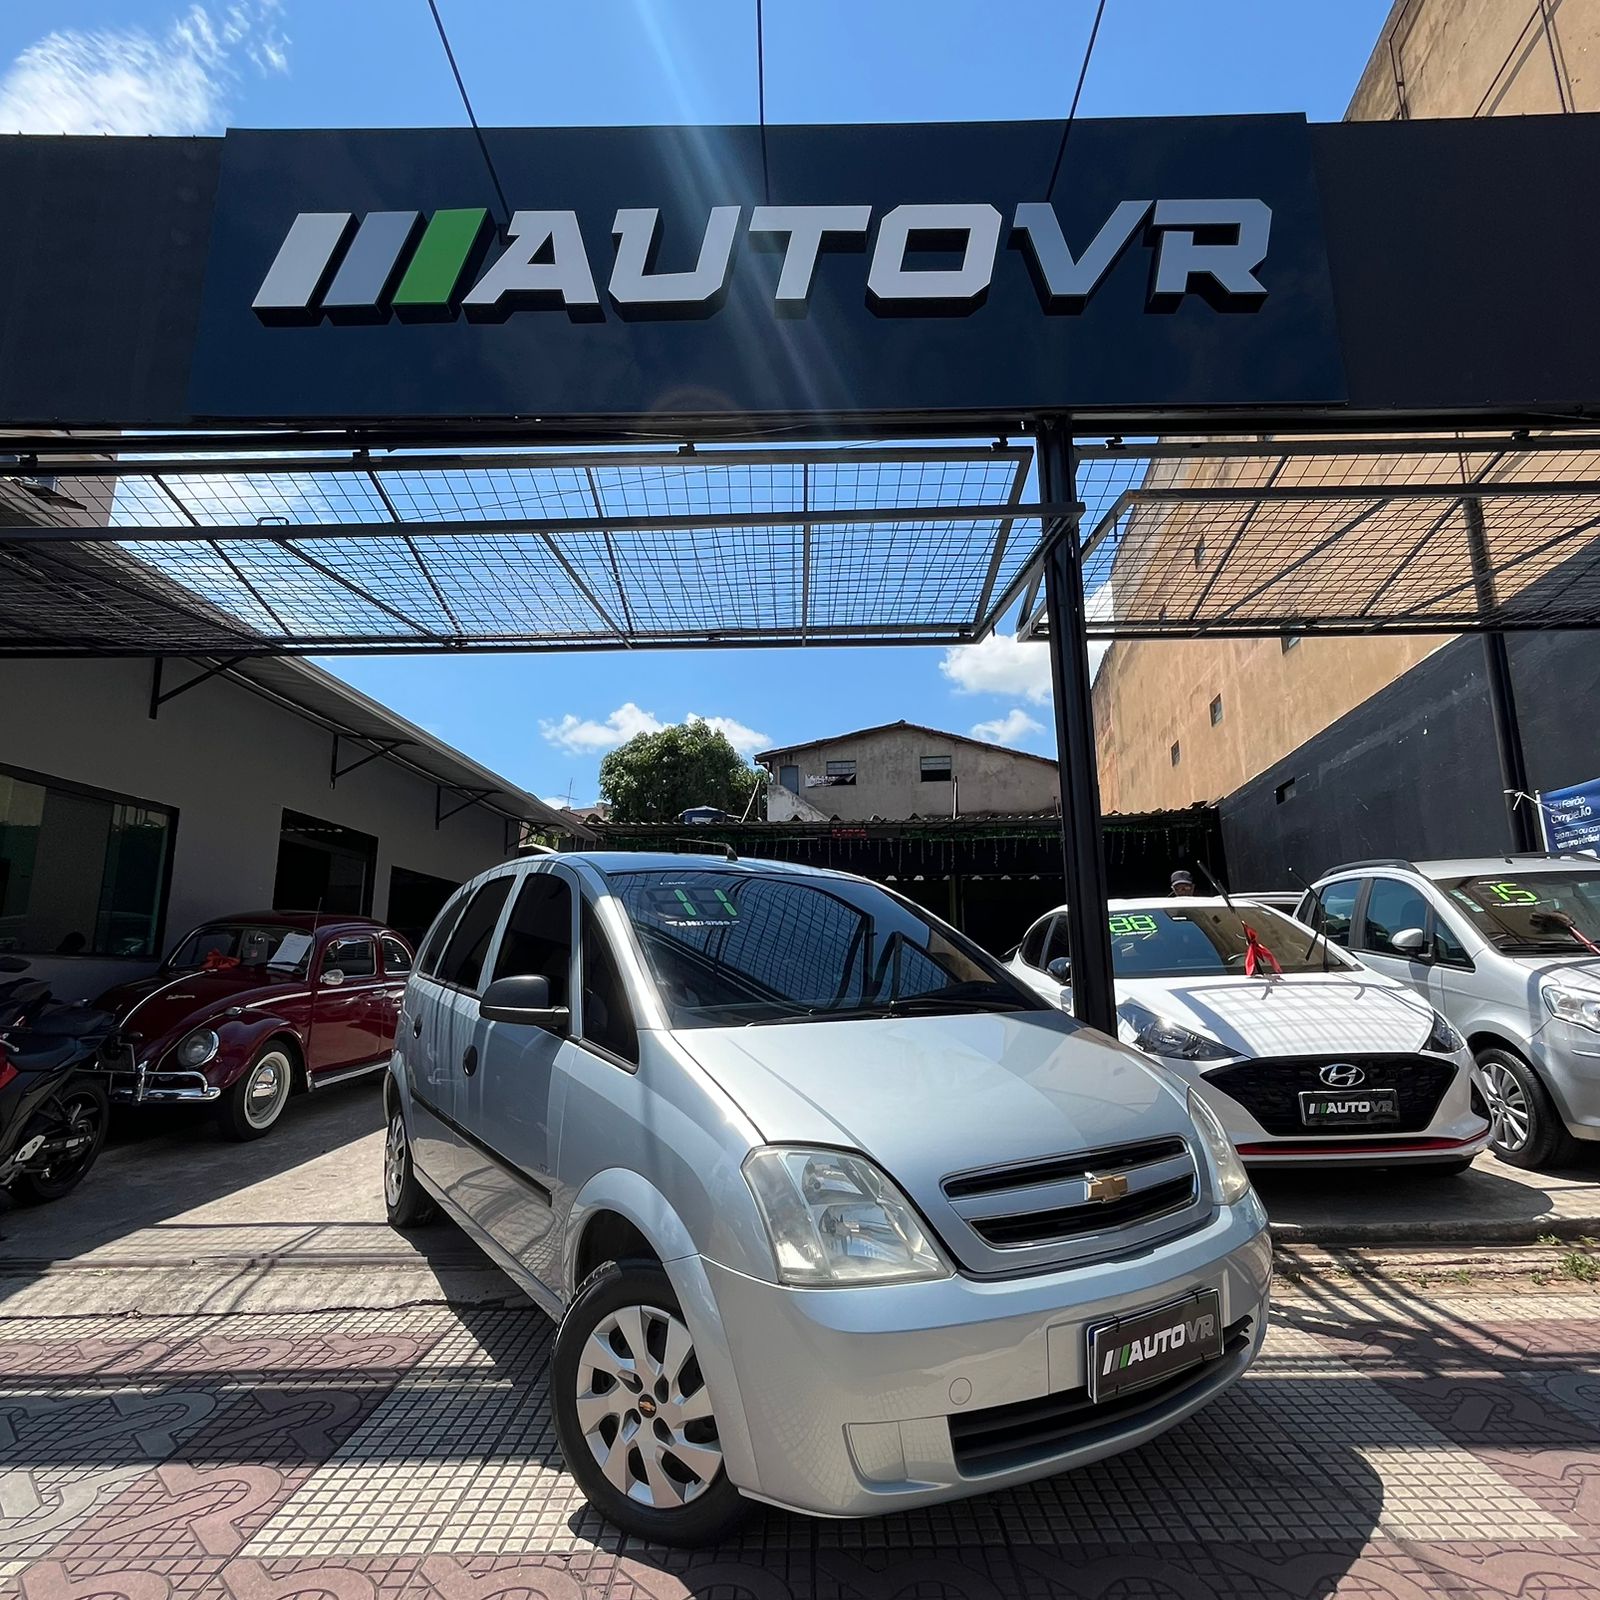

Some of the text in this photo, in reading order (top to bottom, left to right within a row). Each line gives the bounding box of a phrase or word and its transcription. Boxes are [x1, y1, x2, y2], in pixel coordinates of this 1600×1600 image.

[461, 198, 1274, 310] AUTOVR
[674, 889, 738, 916] 11
[1489, 883, 1537, 902] 15
[1326, 1101, 1393, 1114] AUTOVR
[1127, 1313, 1215, 1366] AUTOVR
